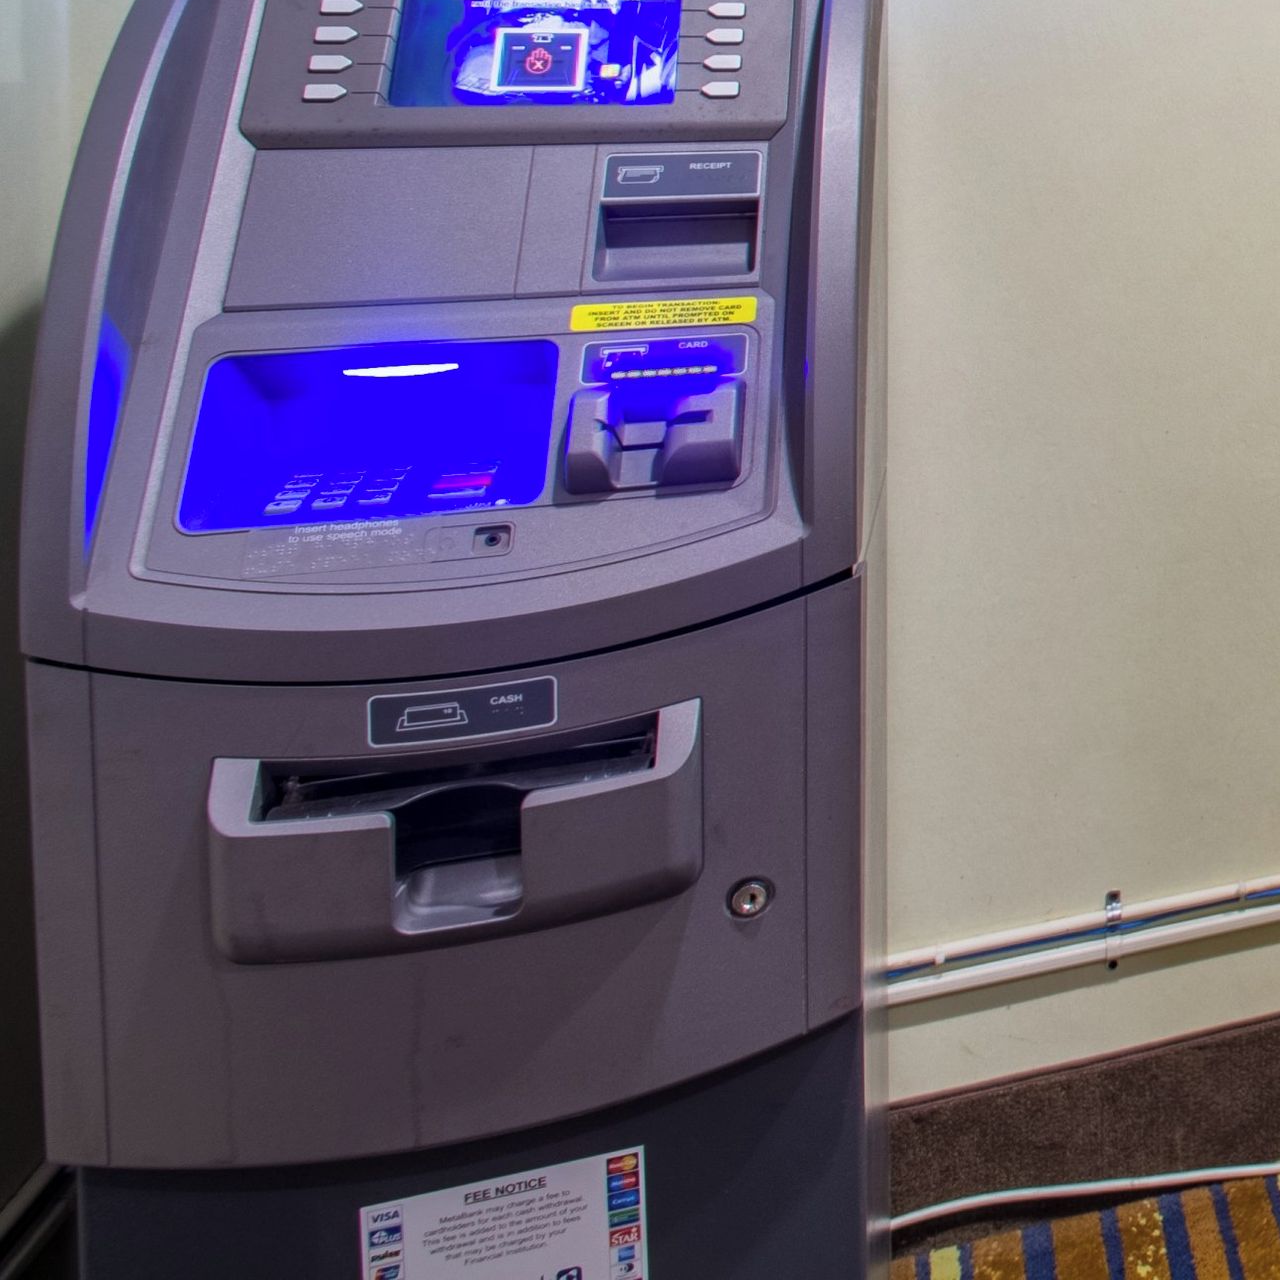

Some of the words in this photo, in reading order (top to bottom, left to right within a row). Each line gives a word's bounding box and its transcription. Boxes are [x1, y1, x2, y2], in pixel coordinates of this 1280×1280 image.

[689, 162, 732, 170] RECEIPT
[671, 311, 720, 319] PROMPTED
[678, 341, 708, 349] CARD
[295, 526, 326, 535] Insert
[329, 520, 399, 532] headphones
[326, 531, 367, 542] speech
[370, 527, 402, 537] mode
[489, 693, 523, 706] CASH
[464, 1188, 492, 1204] FEE
[495, 1176, 547, 1197] NOTICE
[371, 1209, 400, 1224] VISA
[611, 1232, 638, 1246] STAR
